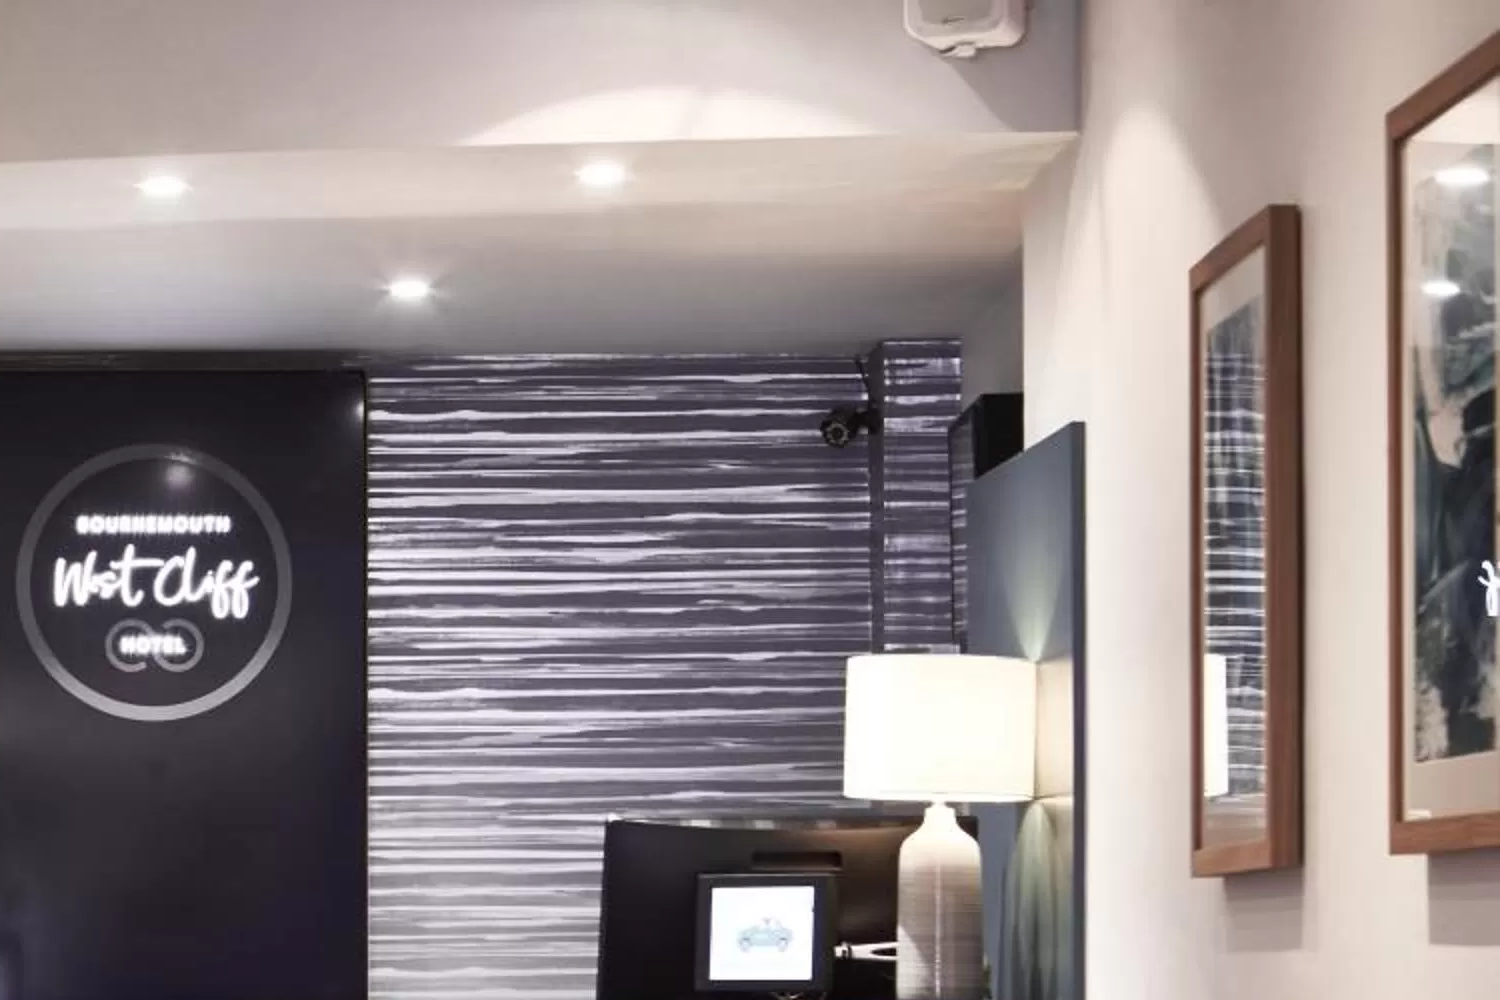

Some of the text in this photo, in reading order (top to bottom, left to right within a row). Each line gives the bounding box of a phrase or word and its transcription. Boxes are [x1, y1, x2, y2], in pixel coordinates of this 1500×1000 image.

[75, 514, 232, 534] BOURNEMOUTH
[53, 543, 260, 619] West Cliff
[119, 634, 187, 655] HOTEL
